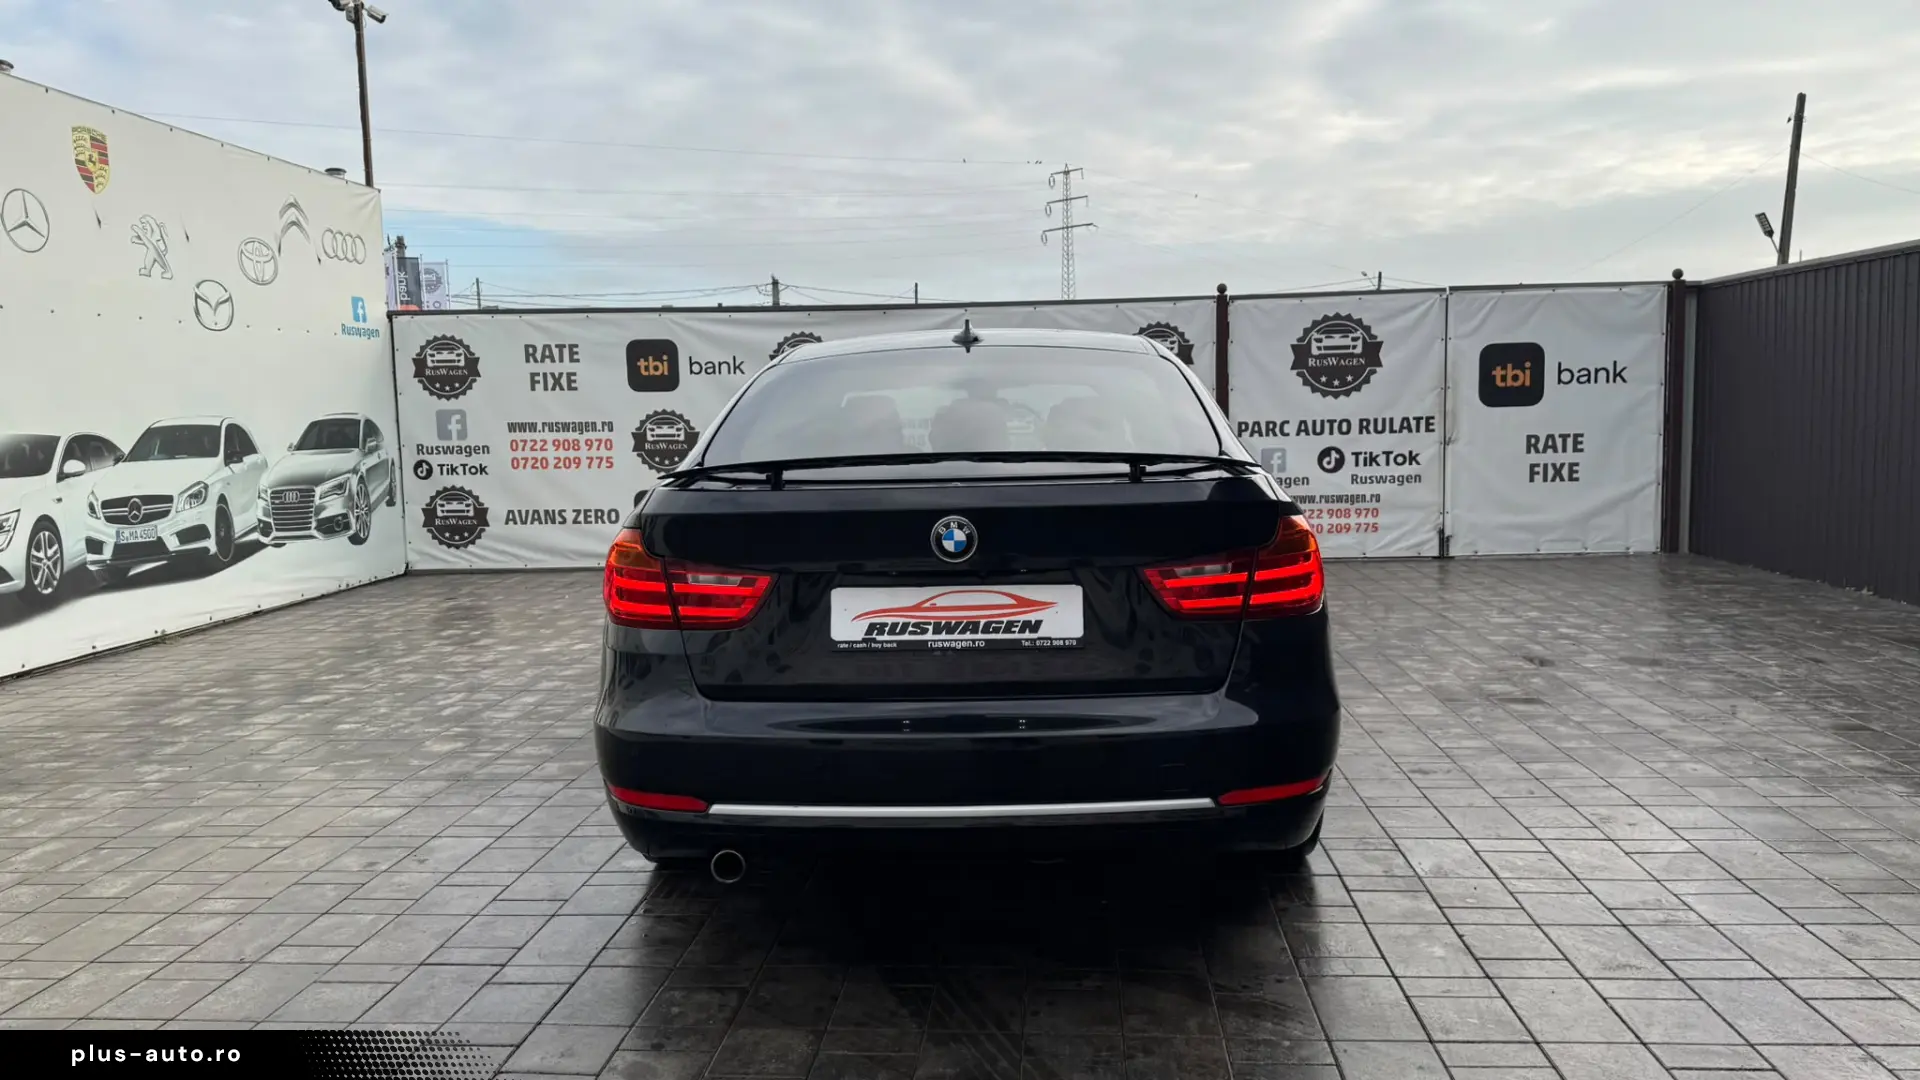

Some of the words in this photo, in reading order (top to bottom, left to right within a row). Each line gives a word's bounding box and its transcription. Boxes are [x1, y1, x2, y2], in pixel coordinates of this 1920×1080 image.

[341, 324, 380, 340] Ruswagen
[524, 343, 580, 364] RATE
[637, 355, 669, 376] tbi
[688, 355, 746, 376] bank
[529, 371, 579, 392] FIXE
[1491, 361, 1532, 388] tbi
[1557, 360, 1628, 385] bank
[507, 421, 614, 435] www.ruswagen.ro
[1237, 420, 1290, 438] PARC
[1295, 418, 1352, 437] AUTO
[1358, 416, 1436, 435] RULATE
[416, 443, 490, 457] Ruswagen
[510, 438, 548, 452] 0722
[552, 438, 581, 452] 908
[585, 438, 613, 451] 970
[1525, 433, 1585, 454] RATE
[511, 457, 549, 470] 0720
[553, 456, 582, 470] 209
[586, 456, 614, 469] 775
[1351, 450, 1421, 467] TikTok
[437, 463, 489, 476] TikTok
[1529, 462, 1580, 483] FIXE
[1276, 476, 1309, 488] agen
[1351, 473, 1422, 487] Ruswagen
[504, 508, 567, 525] AVANS
[572, 508, 620, 525] ZERO
[1303, 508, 1324, 519] 22
[1326, 508, 1351, 519] 908
[1355, 507, 1379, 518] 970
[938, 521, 971, 534] BMW
[1327, 523, 1352, 534] 209
[1355, 522, 1379, 533] 775
[864, 619, 1044, 636] RUSWAGEN
[928, 640, 985, 649] ruswagen.ro
